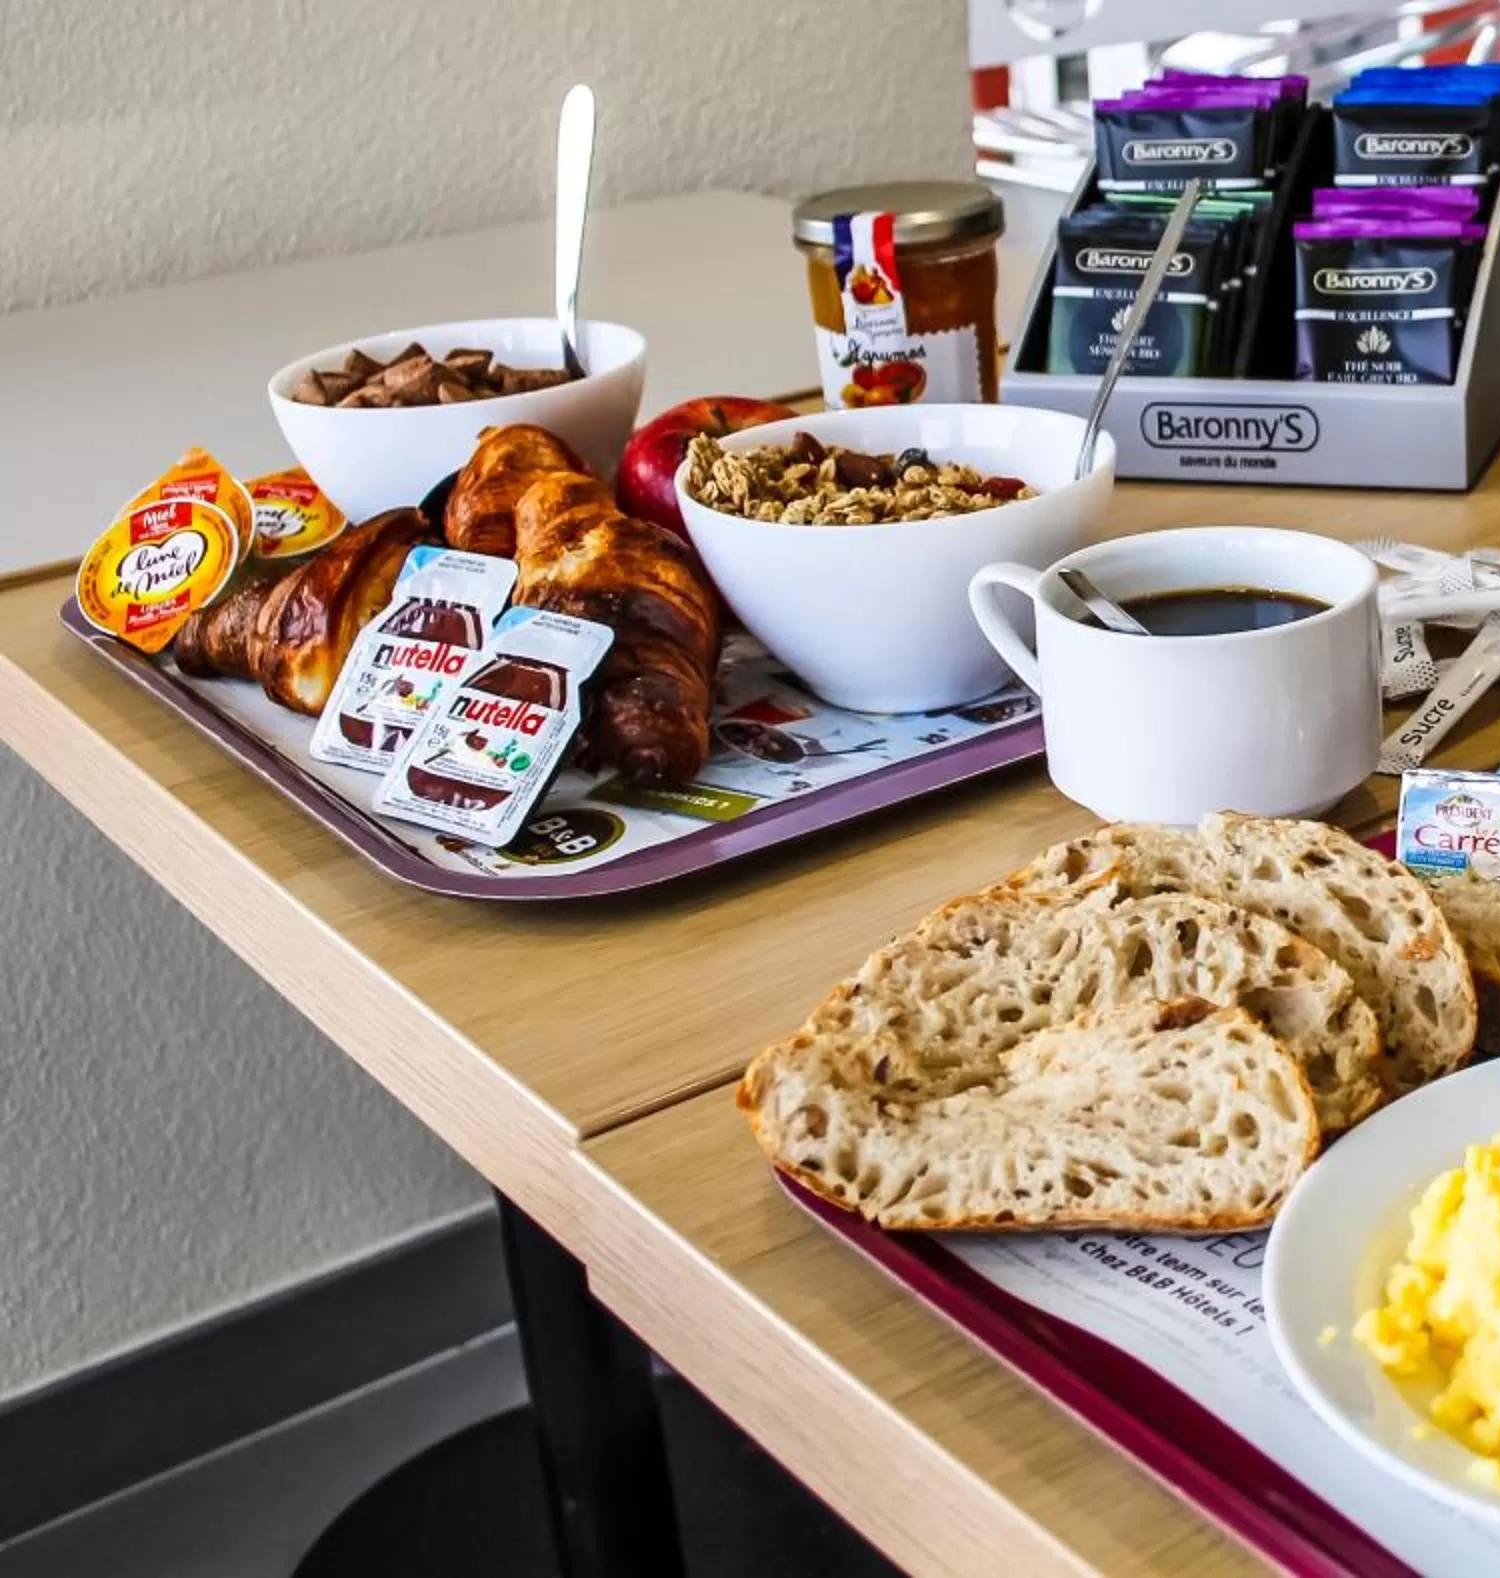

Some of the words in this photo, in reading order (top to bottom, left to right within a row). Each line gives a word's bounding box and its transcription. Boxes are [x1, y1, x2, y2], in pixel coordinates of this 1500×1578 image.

[1156, 410, 1304, 449] Baronny'S
[1240, 457, 1278, 469] monde
[143, 502, 178, 528] Miel
[372, 642, 469, 676] nutella
[449, 694, 548, 737] nutella
[1400, 698, 1455, 746] Sucre
[528, 816, 598, 855] B&B
[1080, 1240, 1129, 1271] chez
[1125, 1263, 1176, 1290] B&B
[1169, 1285, 1238, 1328] Hôtels
[1155, 1251, 1209, 1281] team
[1205, 1277, 1247, 1299] sur
